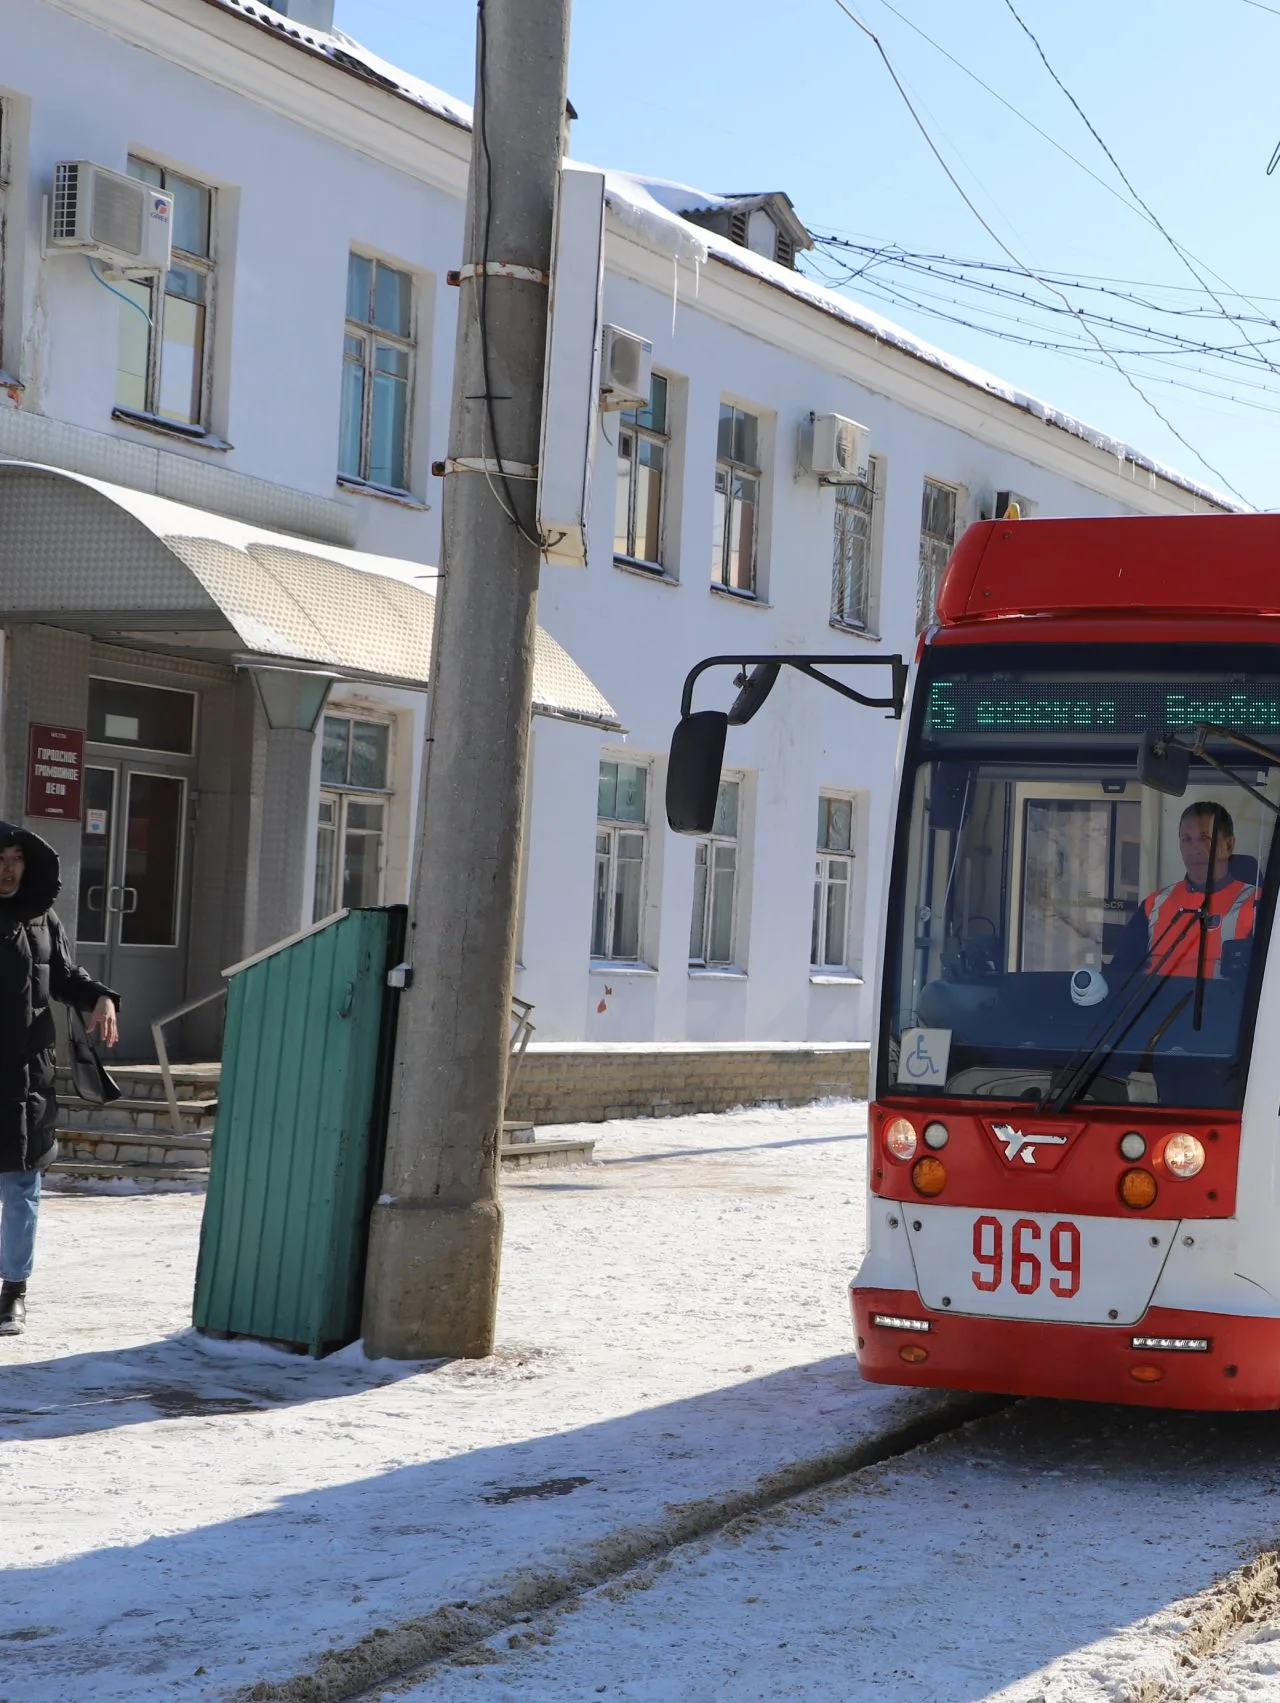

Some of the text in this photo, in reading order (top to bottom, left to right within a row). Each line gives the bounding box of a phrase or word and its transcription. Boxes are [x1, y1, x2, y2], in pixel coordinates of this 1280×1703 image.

[932, 683, 955, 728] 5
[37, 747, 78, 763] ГОРОДСКОЕ
[45, 782, 66, 795] ДЕПО
[971, 1215, 1081, 1299] 969
